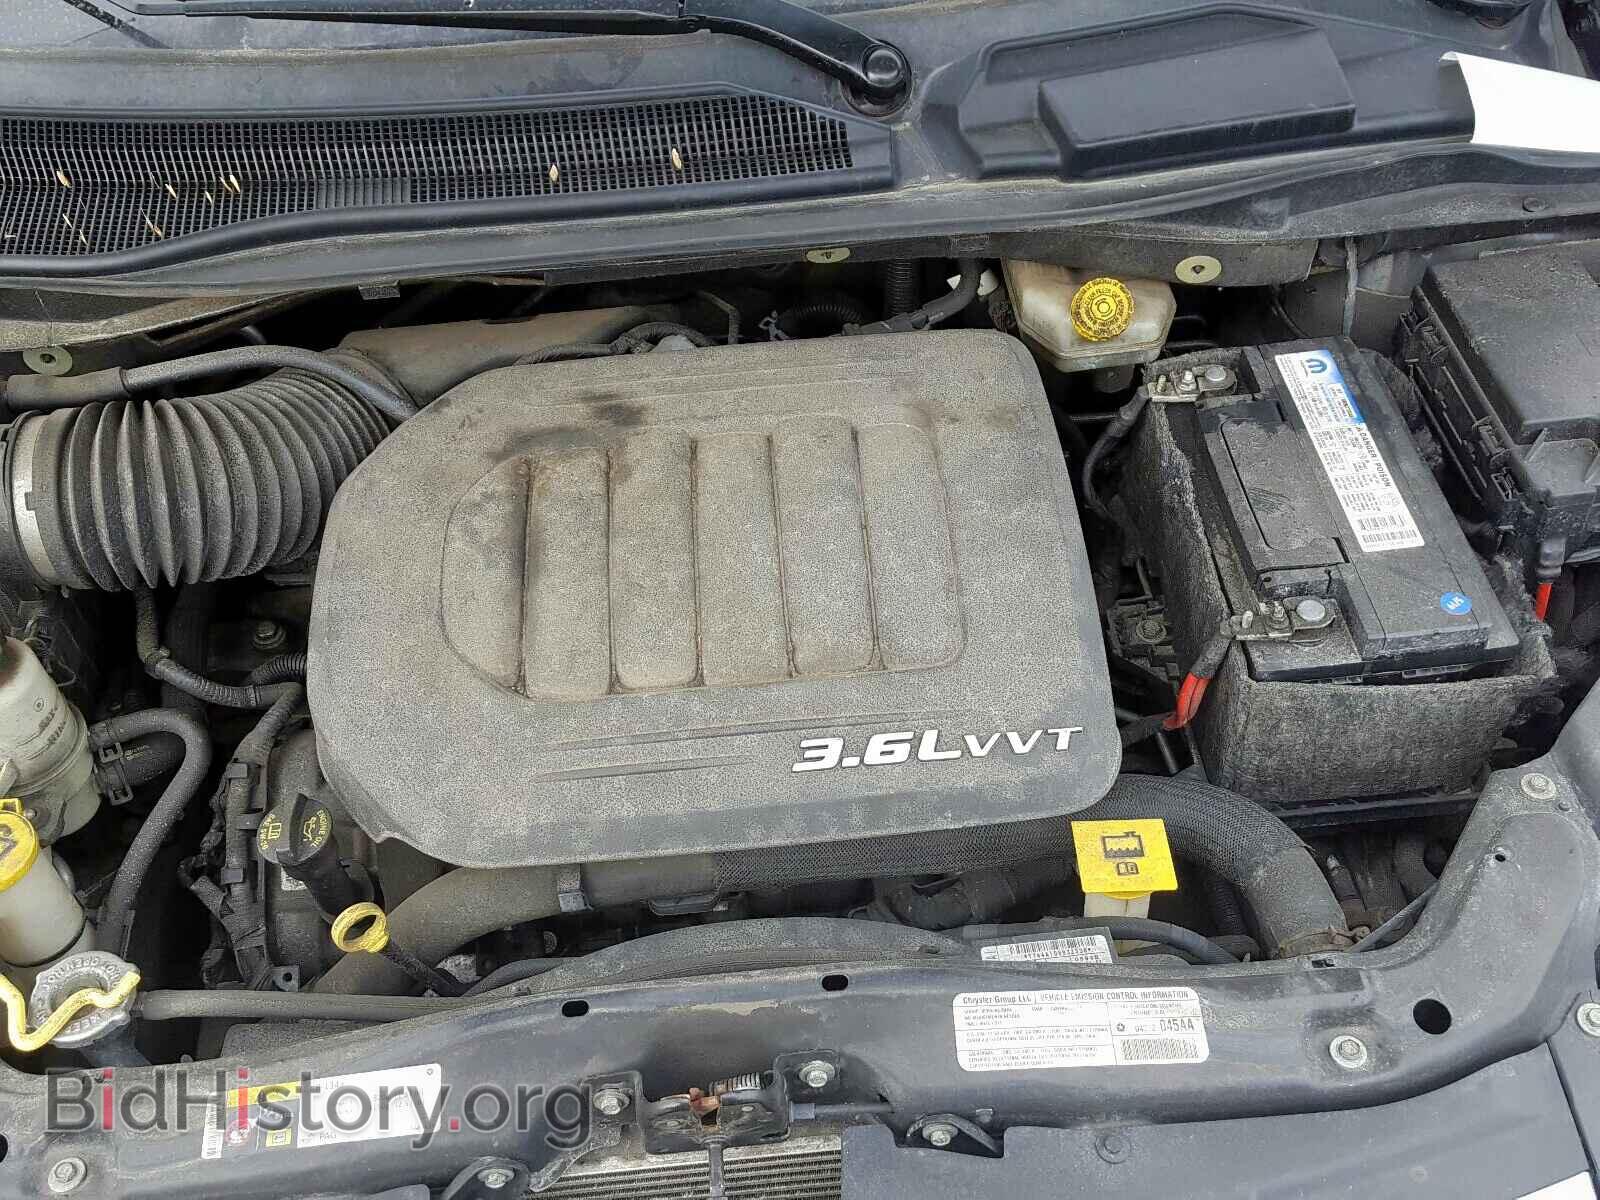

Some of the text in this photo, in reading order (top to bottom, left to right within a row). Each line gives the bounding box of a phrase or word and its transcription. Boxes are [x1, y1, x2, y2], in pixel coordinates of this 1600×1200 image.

[1360, 431, 1392, 488] DANGER POISON
[310, 809, 329, 848] ENGINE OIL
[962, 989, 1190, 1006] Chrysler Group LLC VEHICLE EMISSION CONTROL INFORMATION
